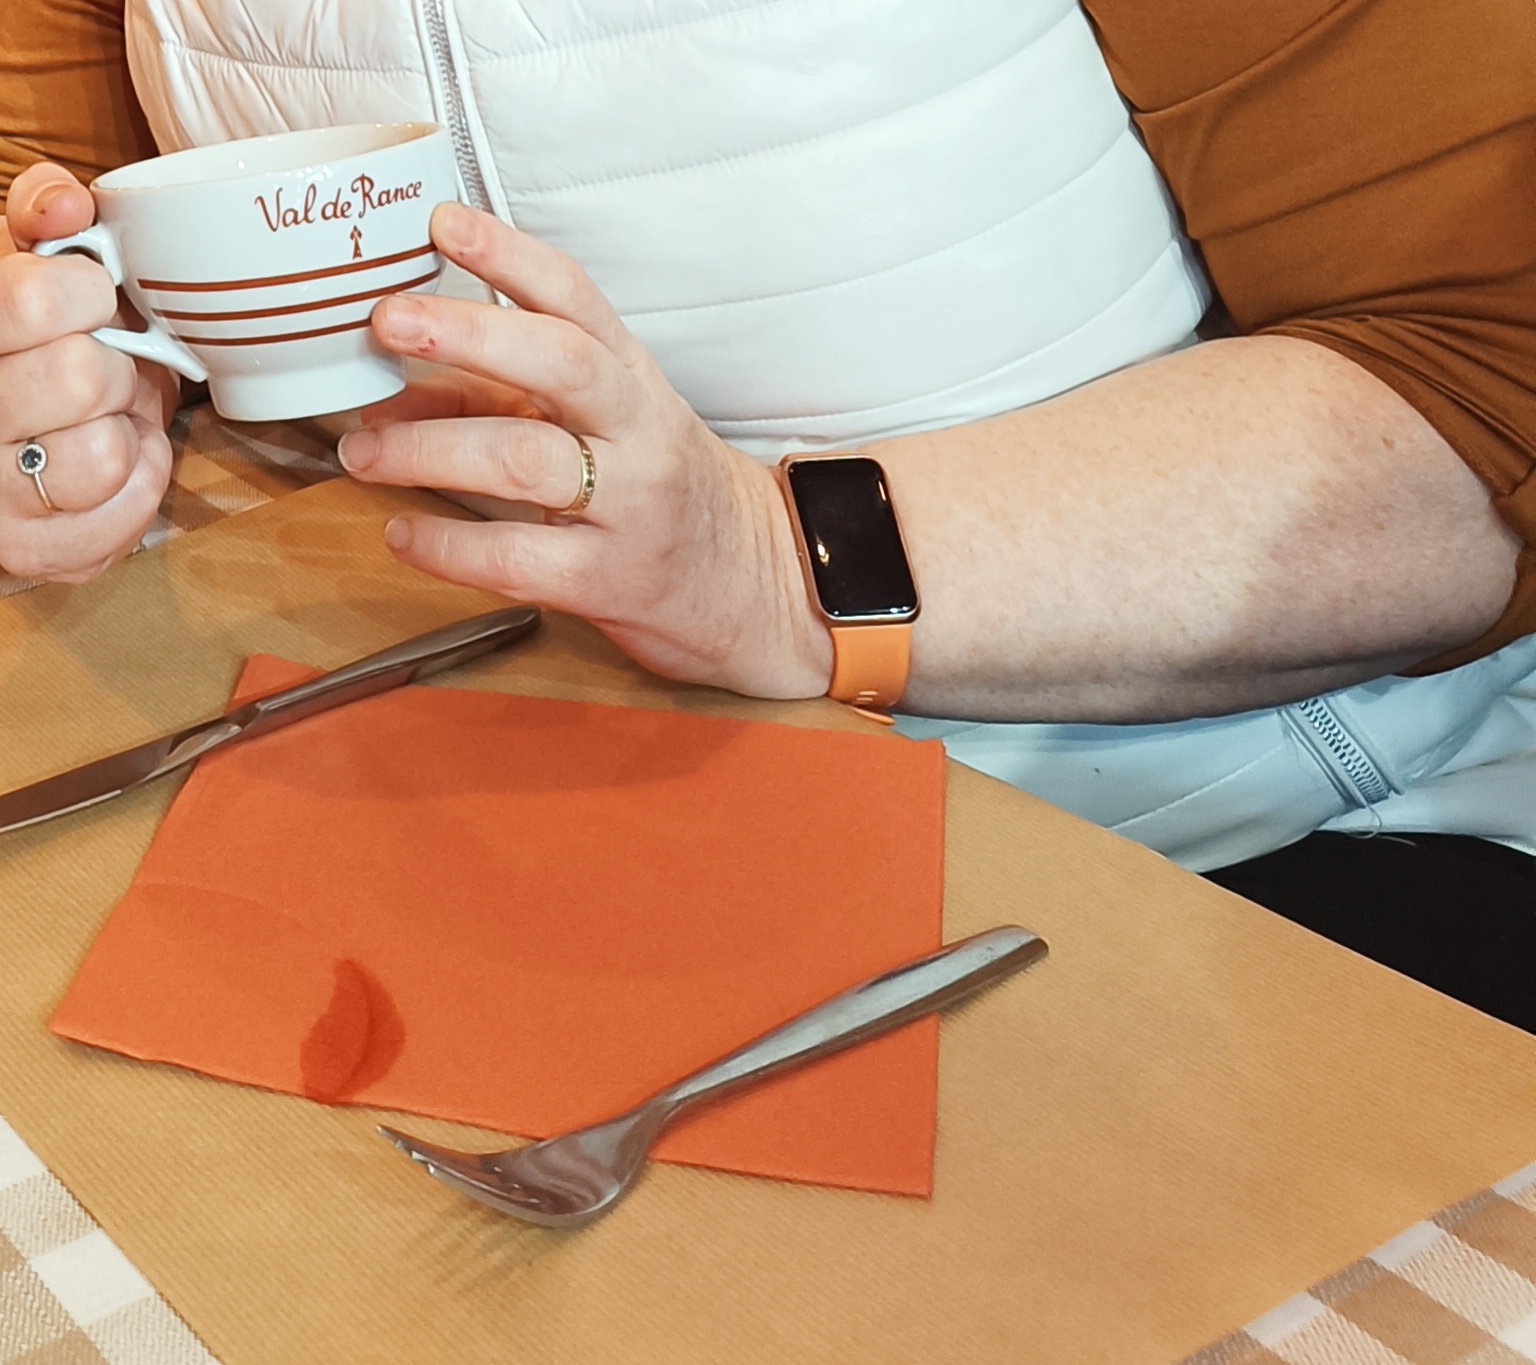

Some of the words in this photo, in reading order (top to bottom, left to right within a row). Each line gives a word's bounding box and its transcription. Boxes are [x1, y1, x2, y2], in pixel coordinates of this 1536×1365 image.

[254, 183, 316, 233] Val
[321, 187, 353, 221] de
[351, 173, 423, 219] Rance
